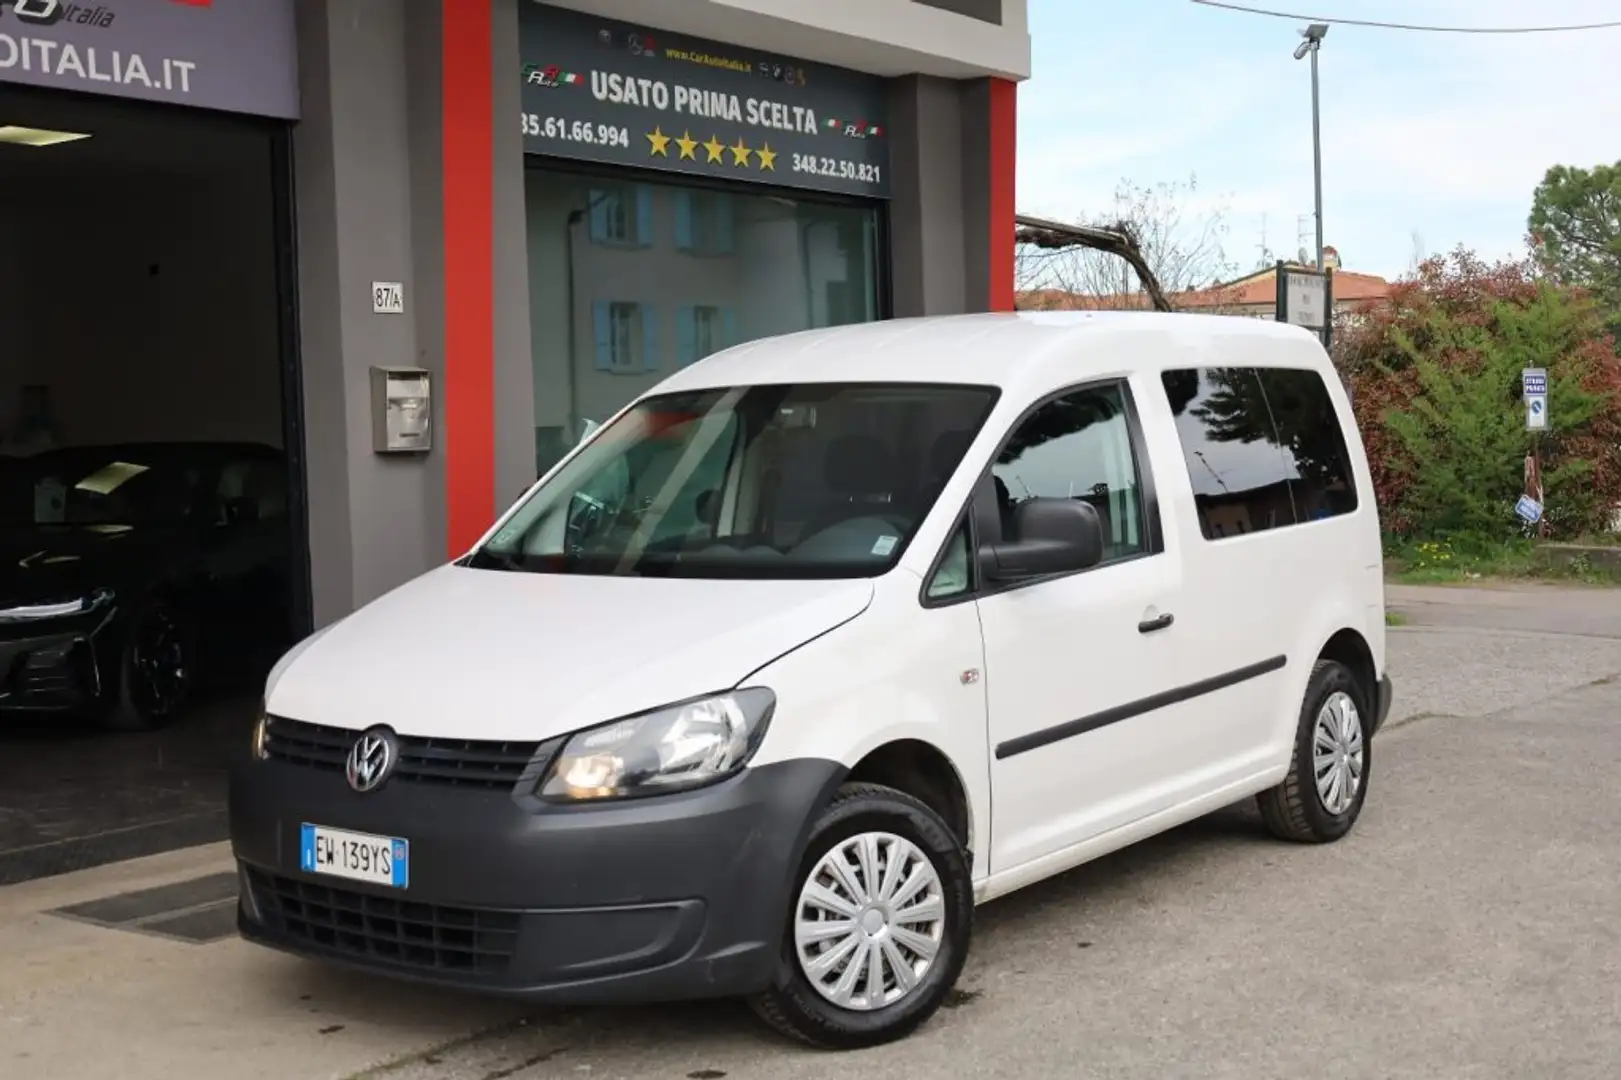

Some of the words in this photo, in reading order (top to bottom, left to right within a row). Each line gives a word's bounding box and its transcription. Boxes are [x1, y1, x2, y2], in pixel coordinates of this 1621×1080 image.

[591, 69, 669, 110] USATO
[674, 84, 743, 122] PRIMA
[746, 97, 818, 135] SCELTA
[792, 152, 881, 183] 348.22.50.821
[375, 287, 400, 307] 87/A
